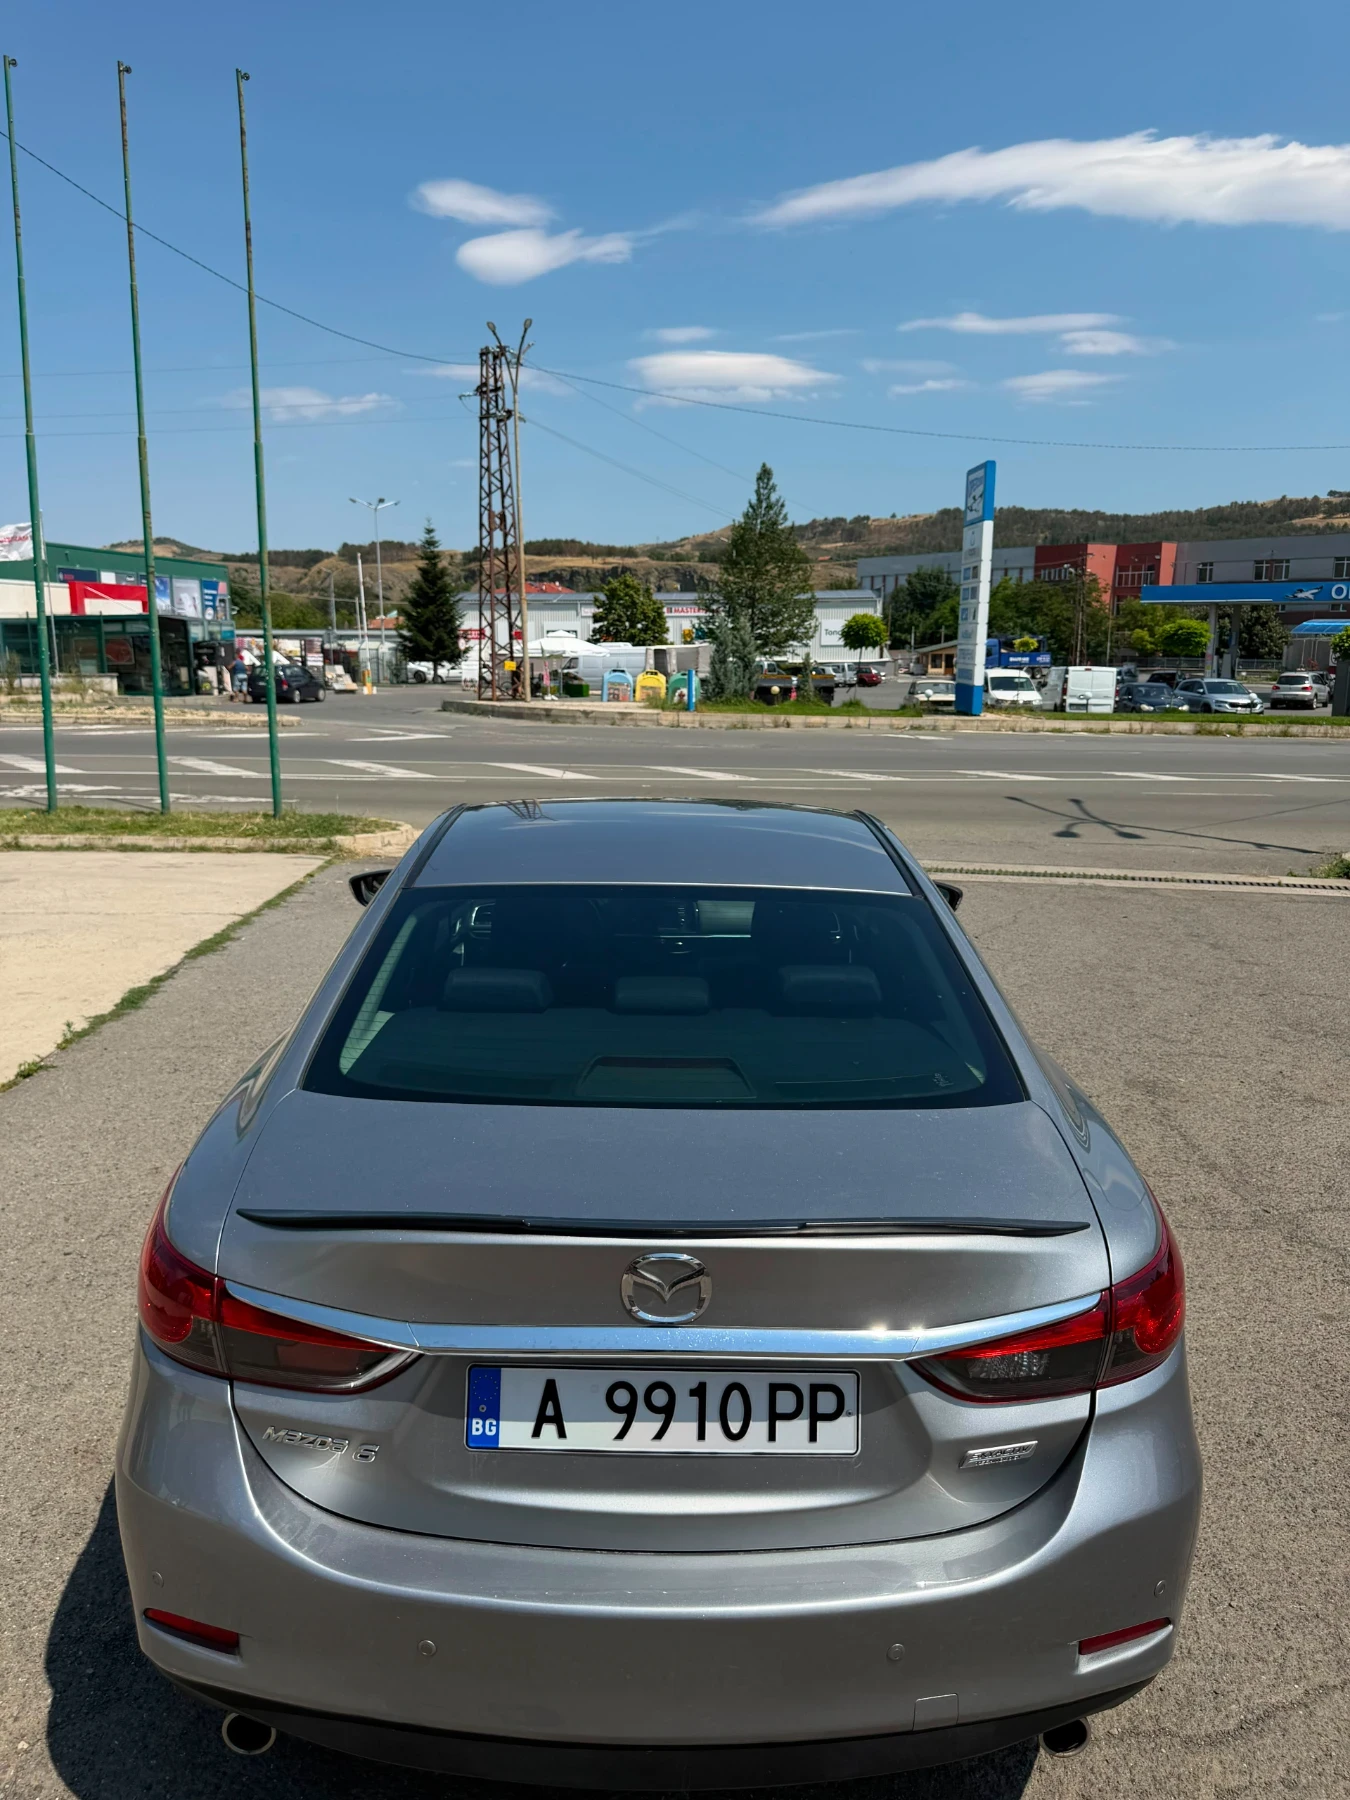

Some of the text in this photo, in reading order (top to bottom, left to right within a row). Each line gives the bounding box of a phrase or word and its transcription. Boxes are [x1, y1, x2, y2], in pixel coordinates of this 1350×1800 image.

[531, 1378, 567, 1439] A
[471, 1418, 497, 1436] BG
[352, 1444, 380, 1463] 6
